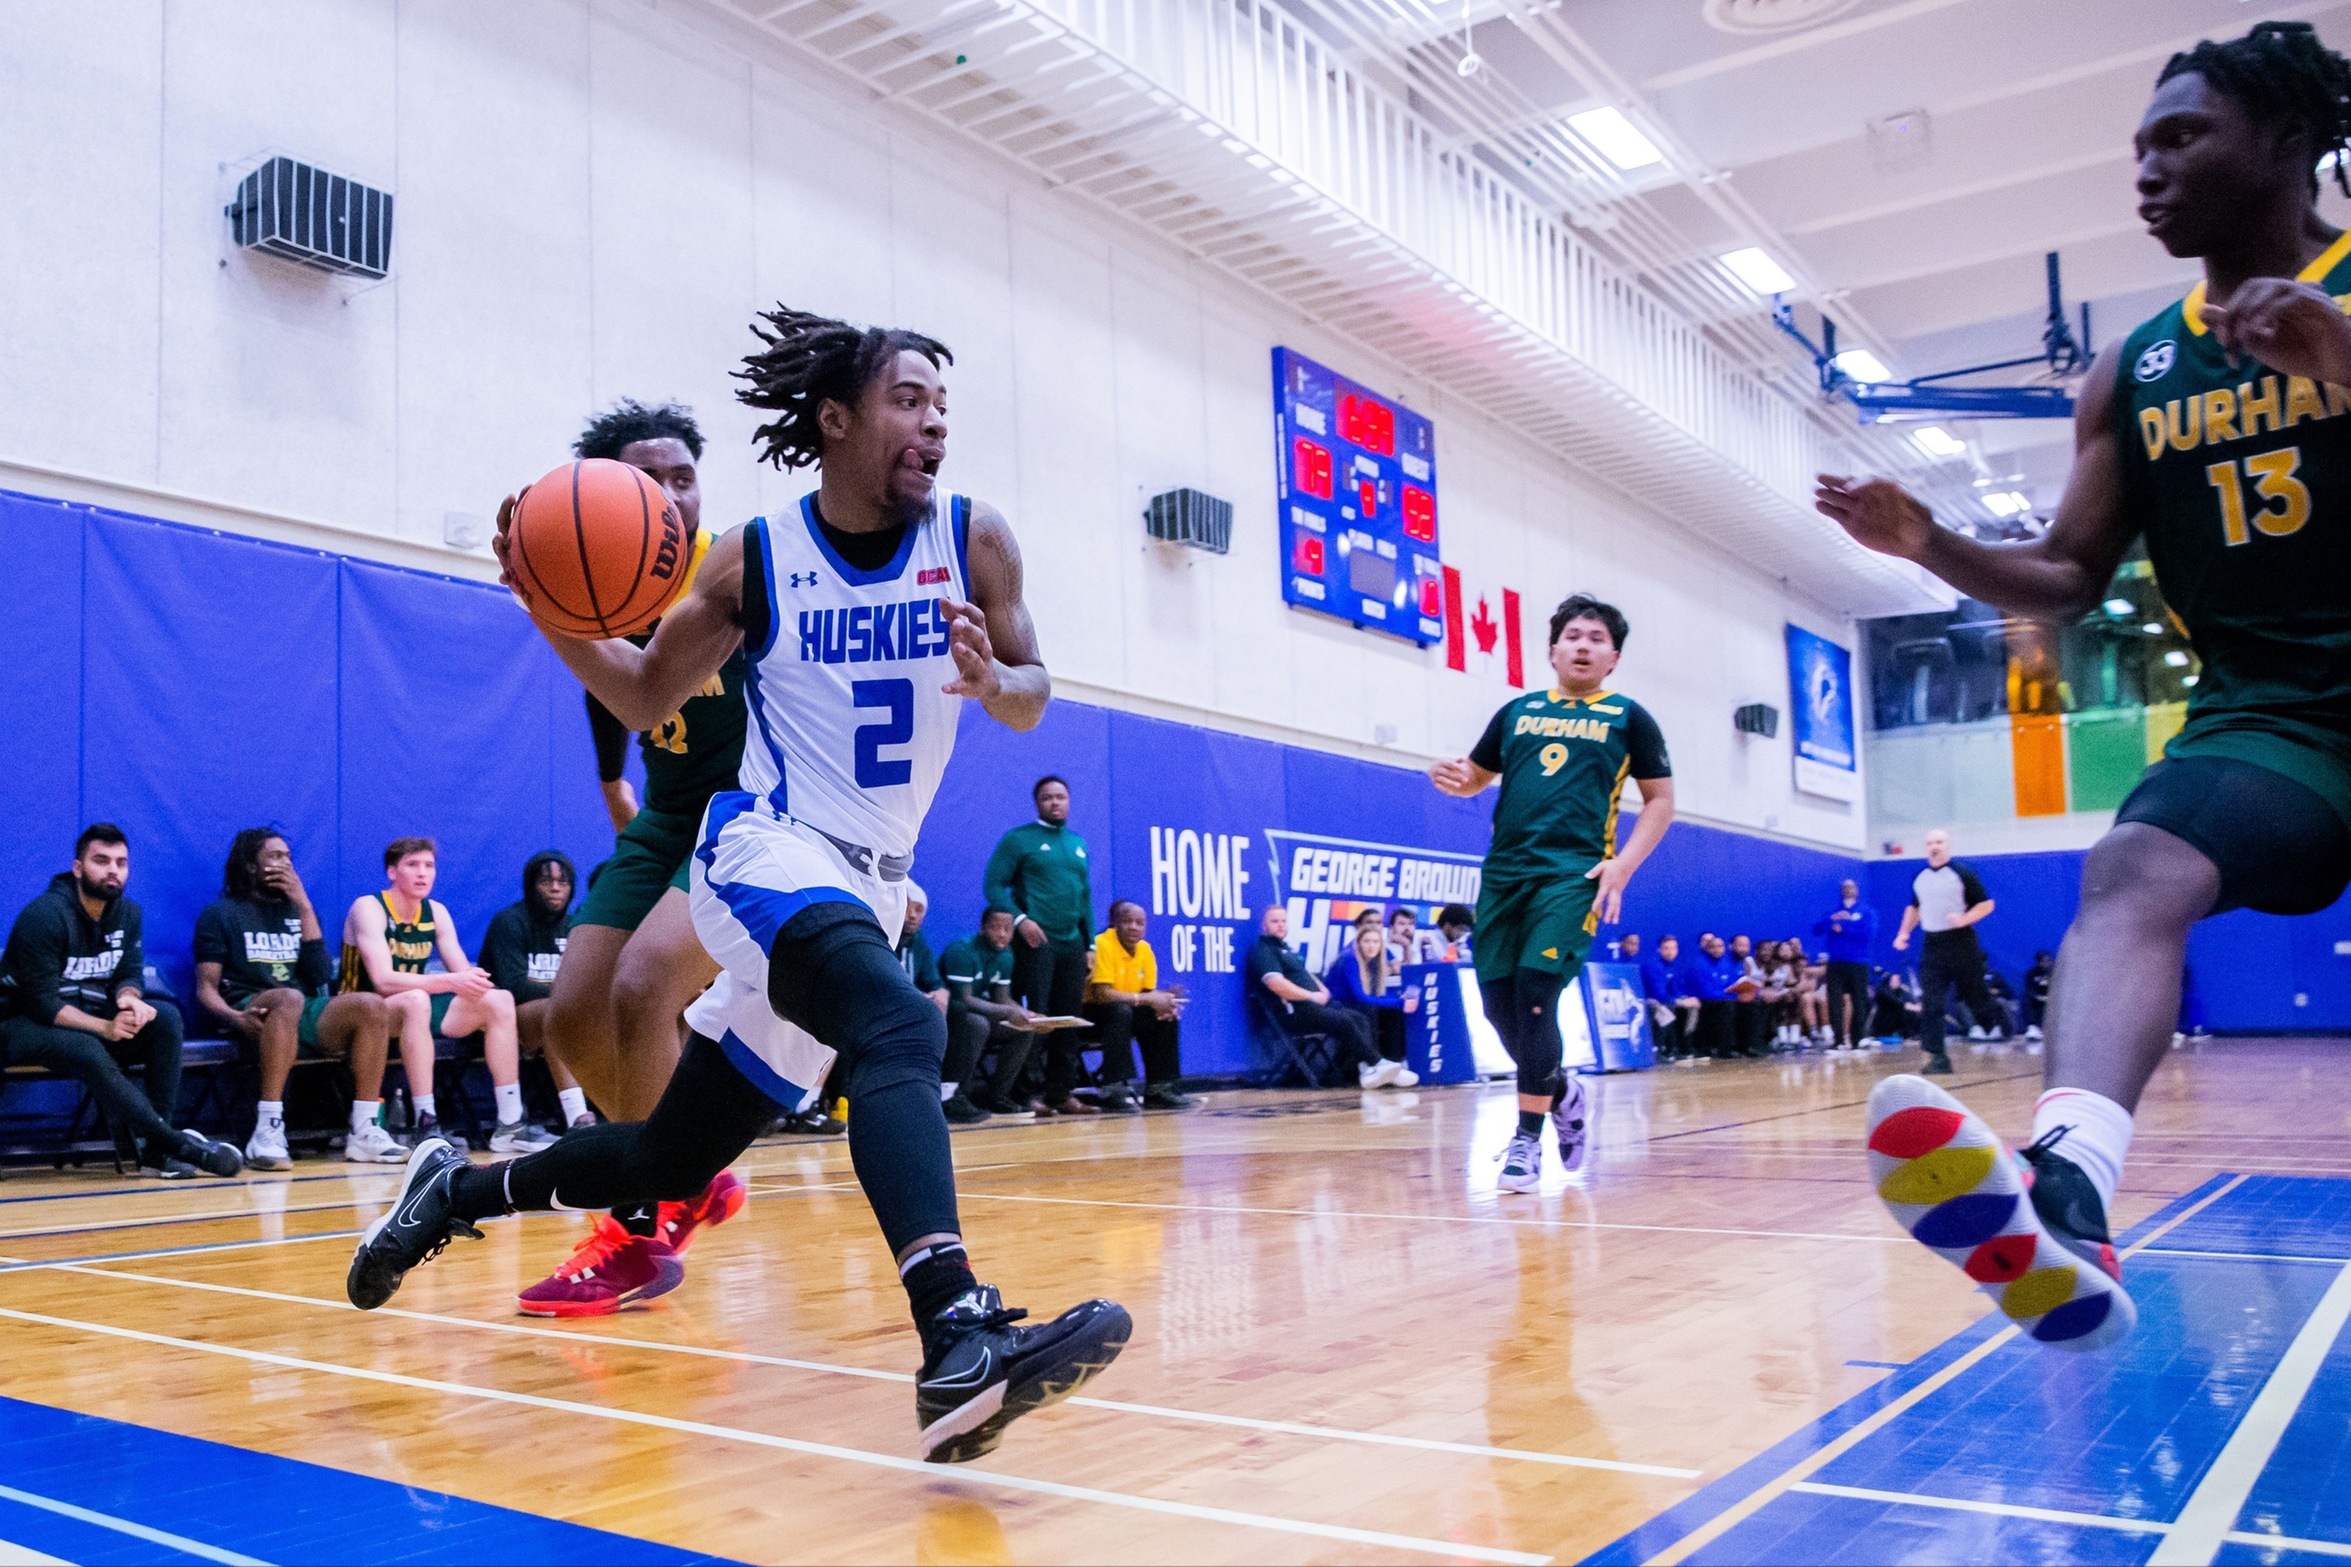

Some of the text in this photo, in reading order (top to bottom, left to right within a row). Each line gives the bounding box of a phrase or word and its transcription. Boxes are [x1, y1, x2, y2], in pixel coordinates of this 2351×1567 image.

[2206, 446, 2312, 546] 13
[799, 596, 951, 664] HUSKIES
[851, 677, 914, 789] 2
[1514, 715, 1610, 744] DURHAM
[1539, 743, 1569, 777] 9
[1150, 826, 1250, 920] HOME
[1290, 846, 1481, 904] GEORGE BROWN
[1171, 924, 1197, 973] OF
[1199, 925, 1236, 973] THE
[1423, 972, 1443, 1073] HUSKIES
